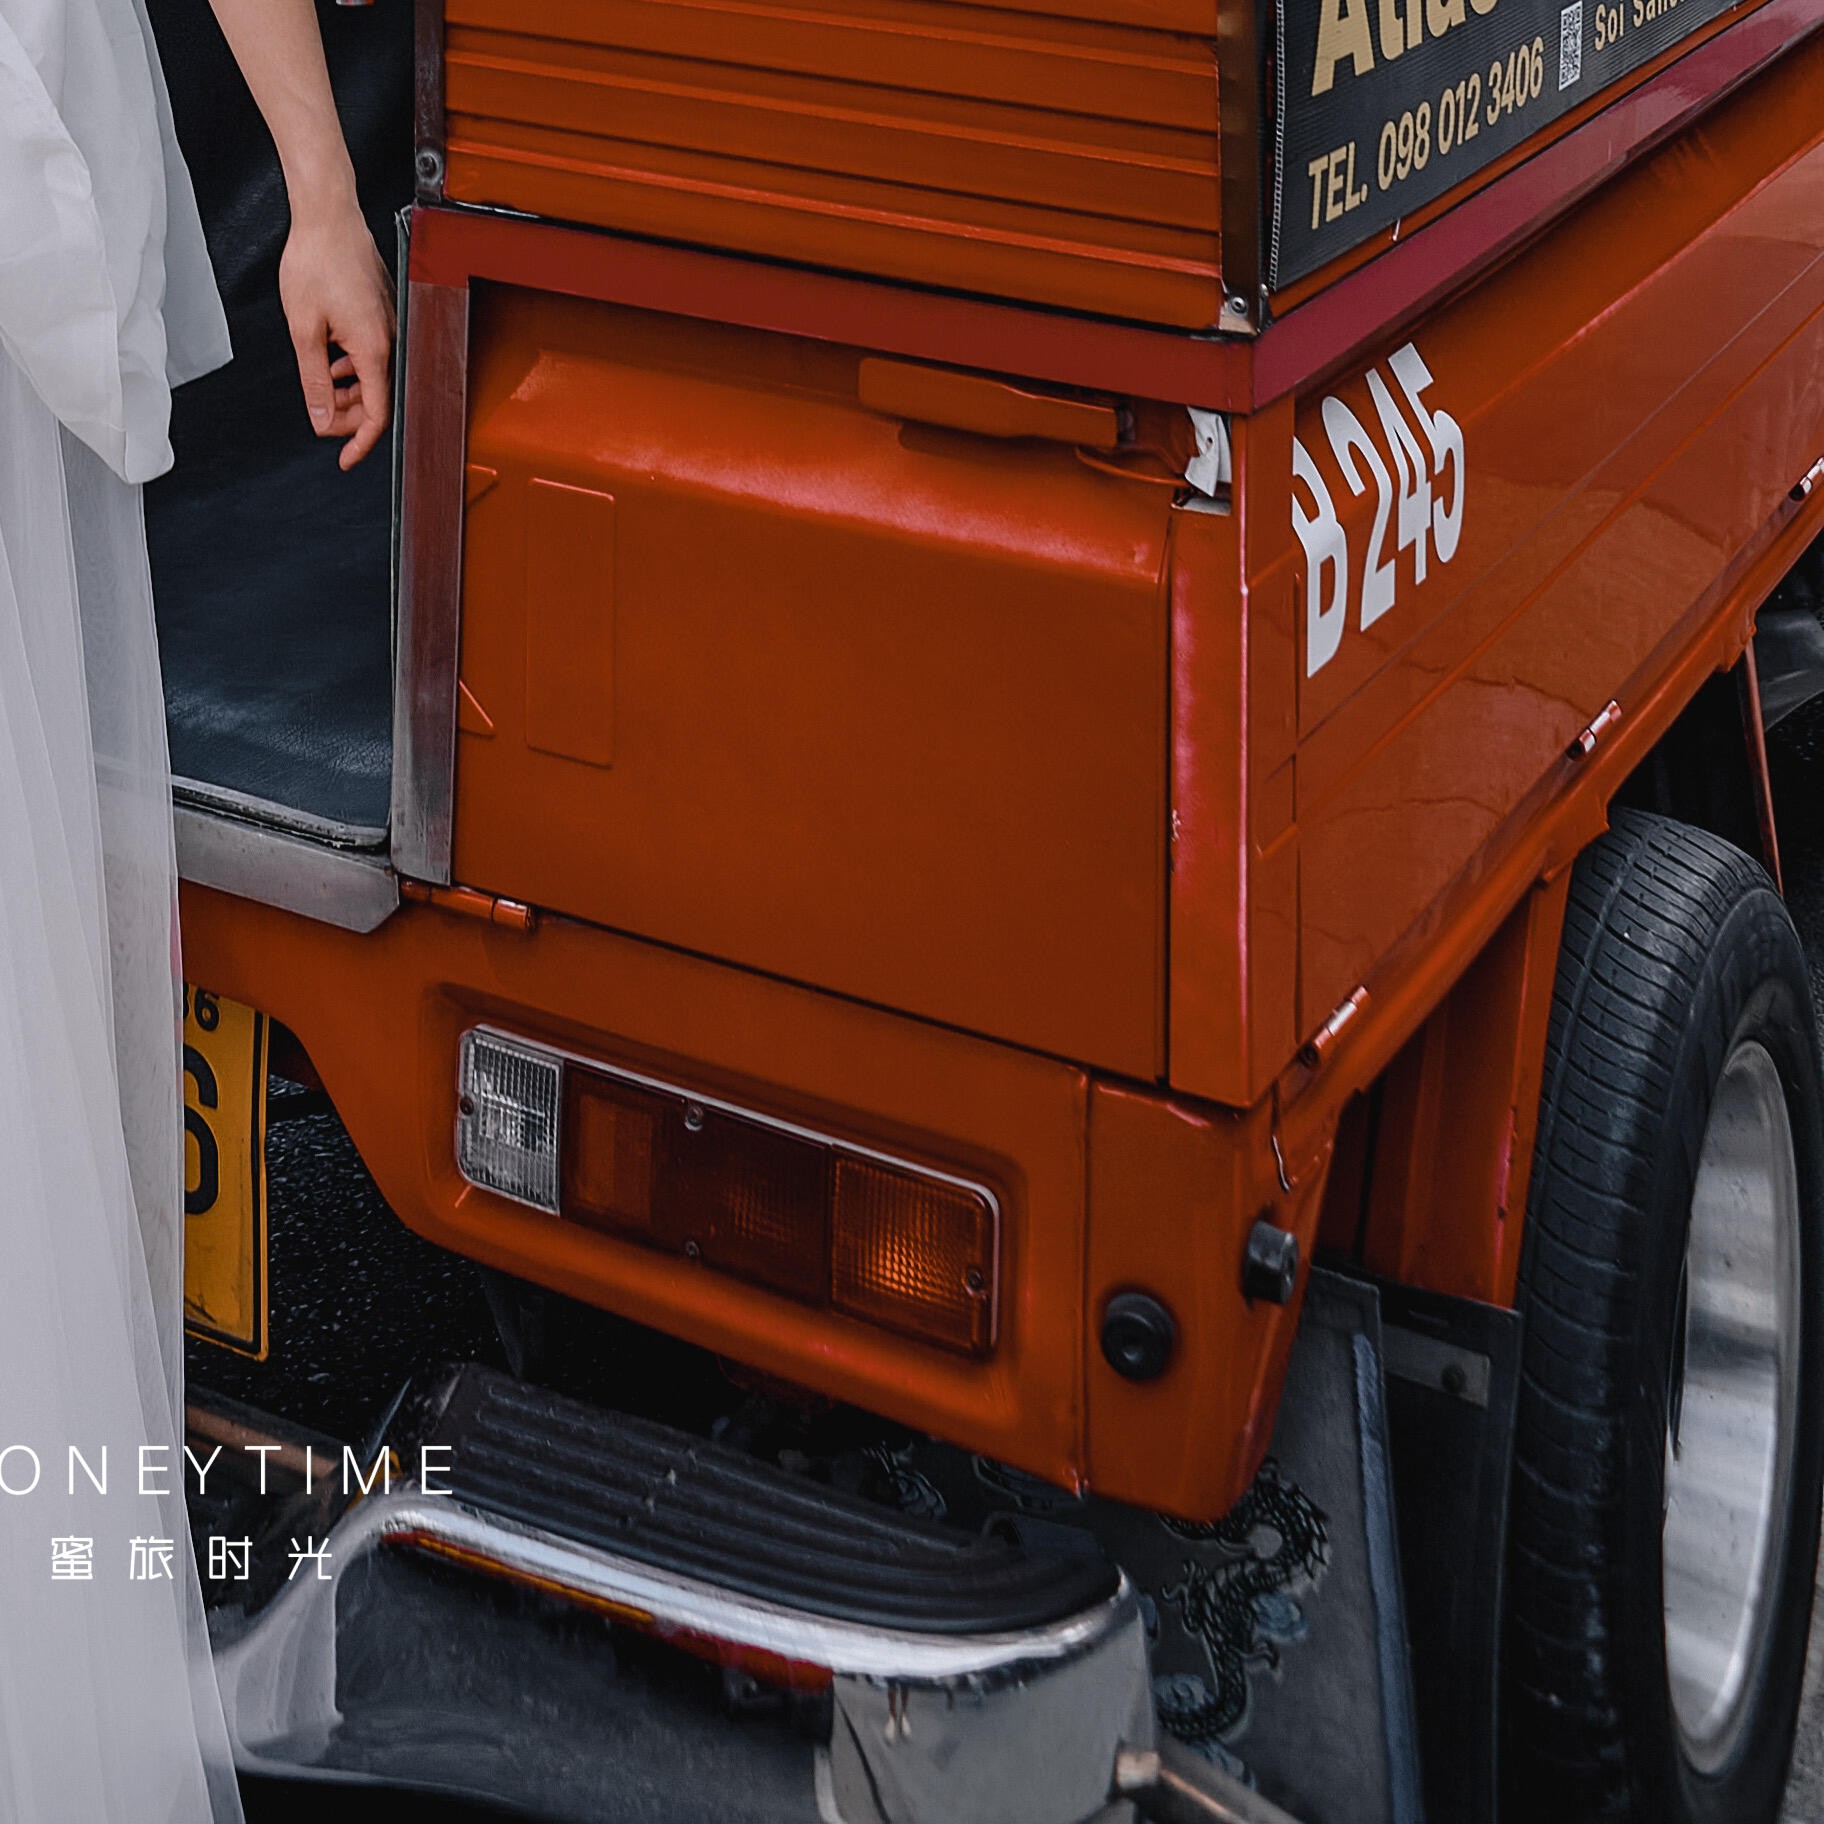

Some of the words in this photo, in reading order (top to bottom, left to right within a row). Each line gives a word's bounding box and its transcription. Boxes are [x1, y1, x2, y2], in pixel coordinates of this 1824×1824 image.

[1308, 141, 1368, 230] TEL.
[1378, 102, 1431, 190] 098
[1438, 73, 1481, 155] 012
[1486, 36, 1544, 126] 3406
